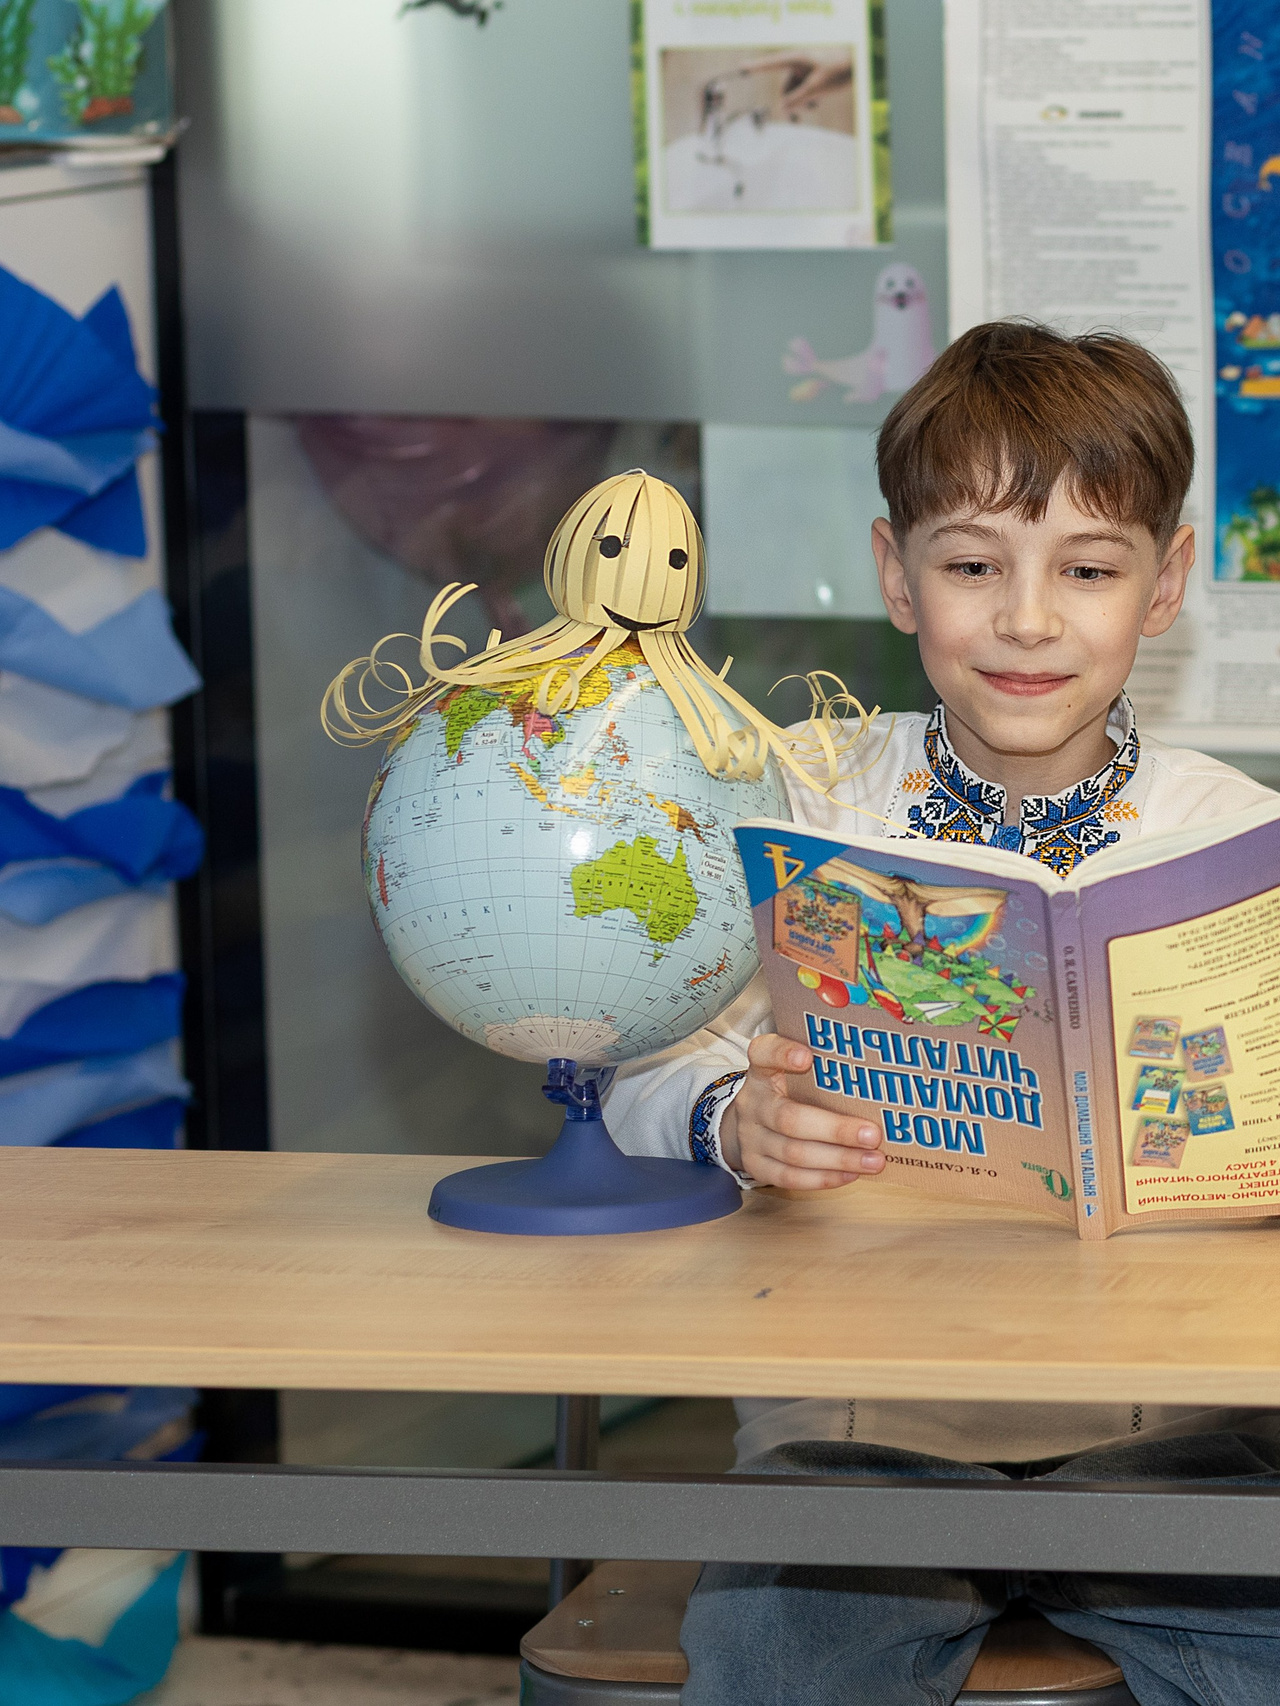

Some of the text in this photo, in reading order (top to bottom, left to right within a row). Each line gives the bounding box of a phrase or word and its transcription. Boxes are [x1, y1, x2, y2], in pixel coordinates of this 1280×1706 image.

[704, 852, 726, 864] Australia
[704, 862, 725, 873] Oceania
[763, 841, 806, 890] 4
[586, 878, 672, 897] AUSTRALIA
[1065, 970, 1081, 1030] САВЧЕНКО
[803, 1011, 1040, 1091] ЧИТАЛЬНЯ
[812, 1053, 1044, 1131] ДОМАШНЯ
[1073, 1070, 1088, 1093] МОЯ
[881, 1107, 987, 1157] МОЯ
[1074, 1095, 1093, 1146] ДОМАШНЯ
[885, 1153, 998, 1178] О. Я. САВЧЕНКО
[1080, 1148, 1098, 1197] ЧИТАЛЬНЯ
[1225, 1160, 1267, 1171] КЛАСУ
[1269, 1159, 1277, 1168] 4
[1136, 1175, 1194, 1186] ЧИТАННЯ
